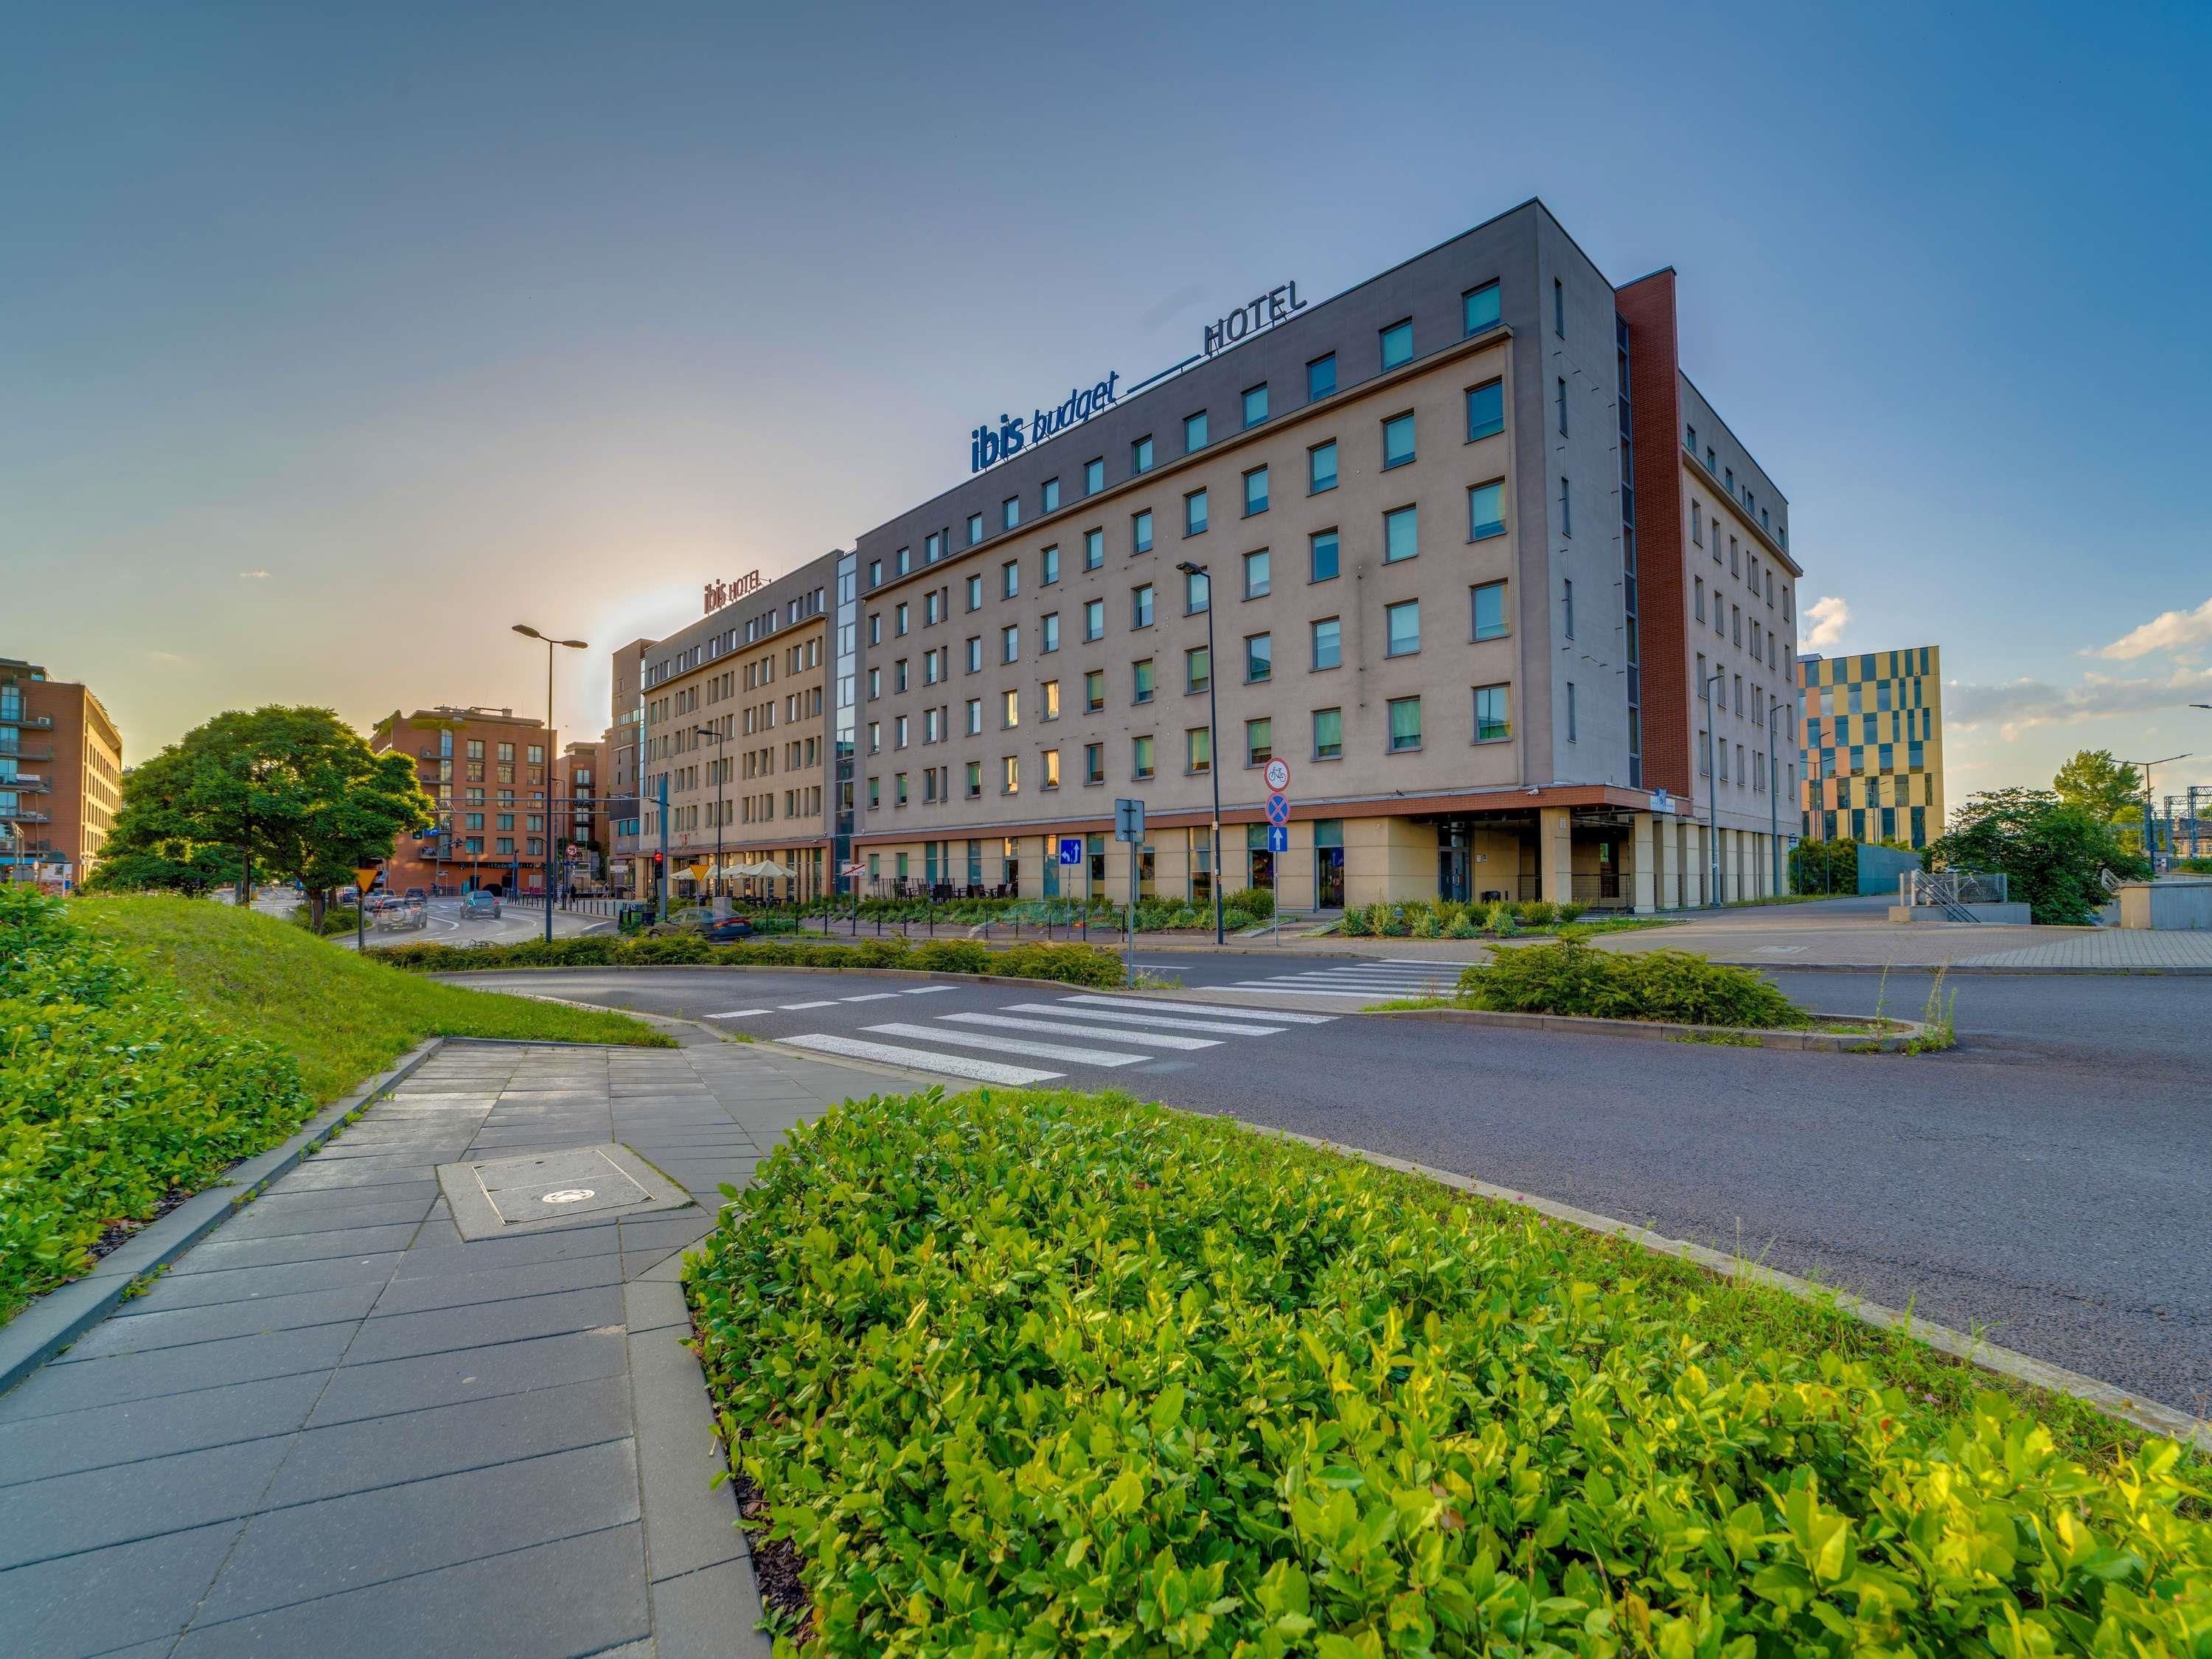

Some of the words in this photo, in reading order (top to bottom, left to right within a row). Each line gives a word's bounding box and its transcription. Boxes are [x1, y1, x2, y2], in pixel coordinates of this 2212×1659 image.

[972, 414, 1024, 473] ibis
[1032, 371, 1119, 443] budget
[1205, 280, 1307, 355] HOTEL
[704, 579, 726, 614] ibis
[728, 569, 762, 601] HOTEL
